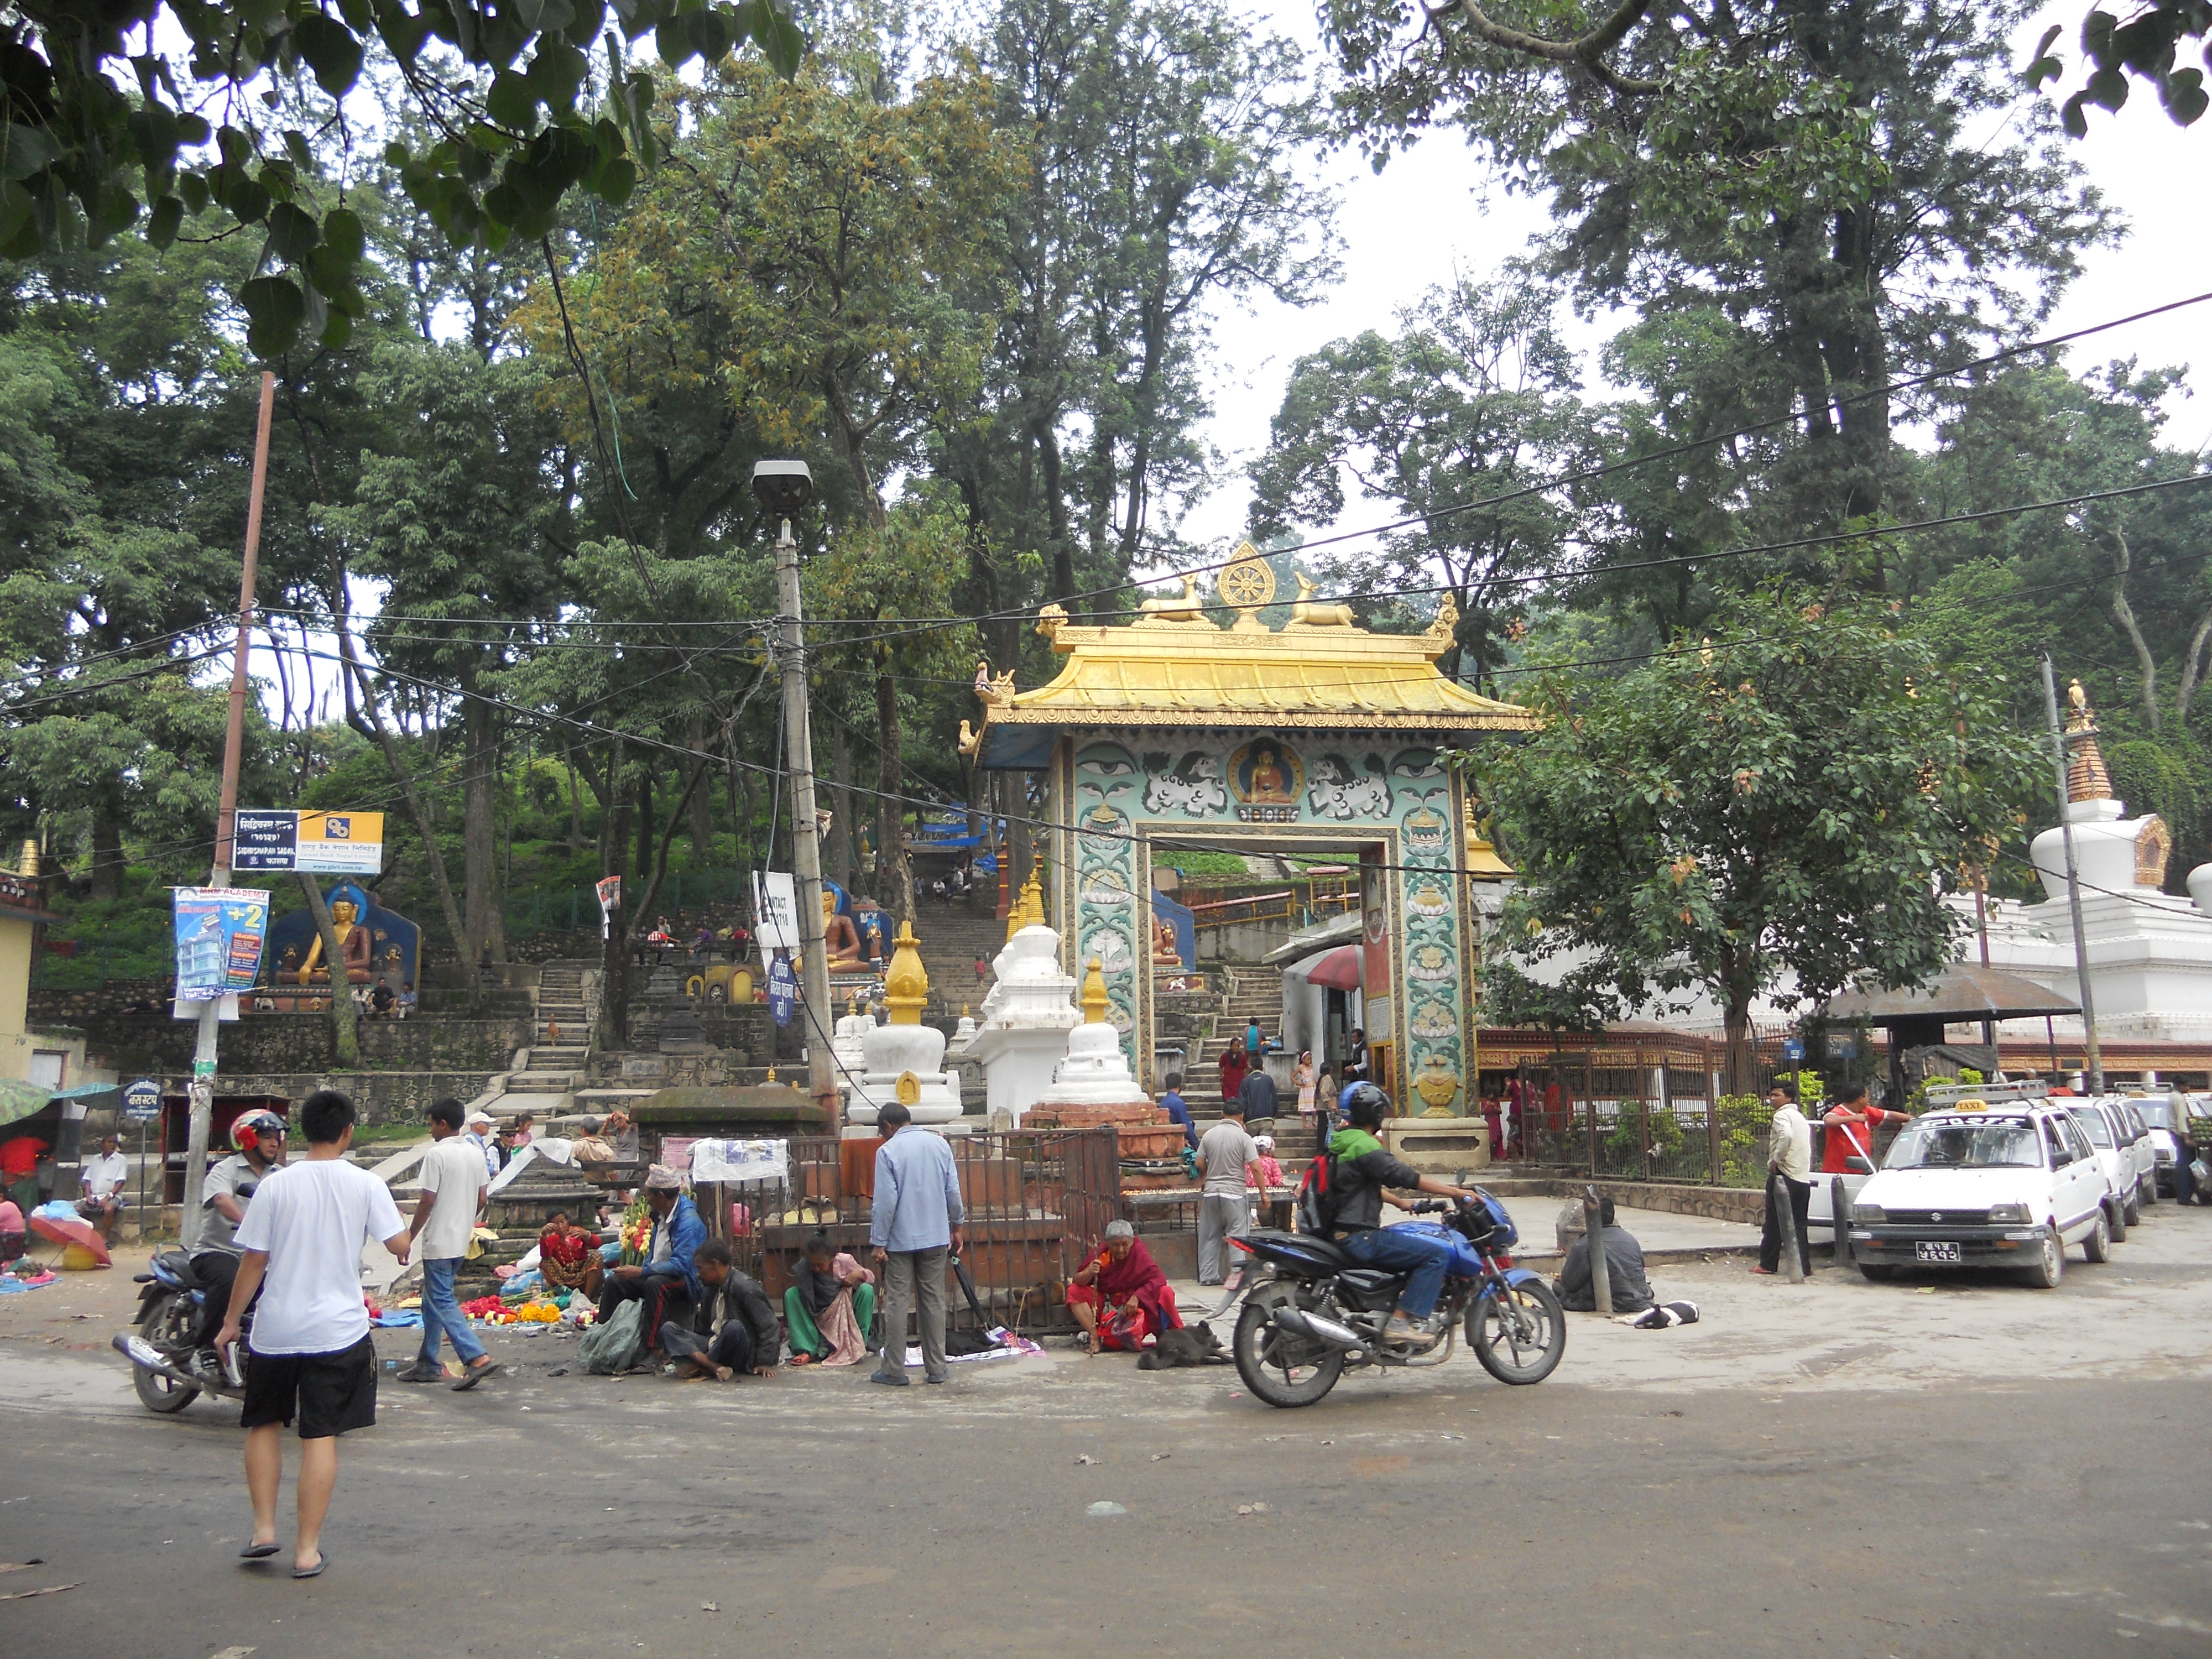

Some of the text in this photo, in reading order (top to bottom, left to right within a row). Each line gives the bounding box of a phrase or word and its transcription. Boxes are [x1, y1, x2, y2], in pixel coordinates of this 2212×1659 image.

[224, 888, 267, 898] ACADEMY
[228, 905, 263, 928] +2
[1913, 1117, 2026, 1130] SPORTS
